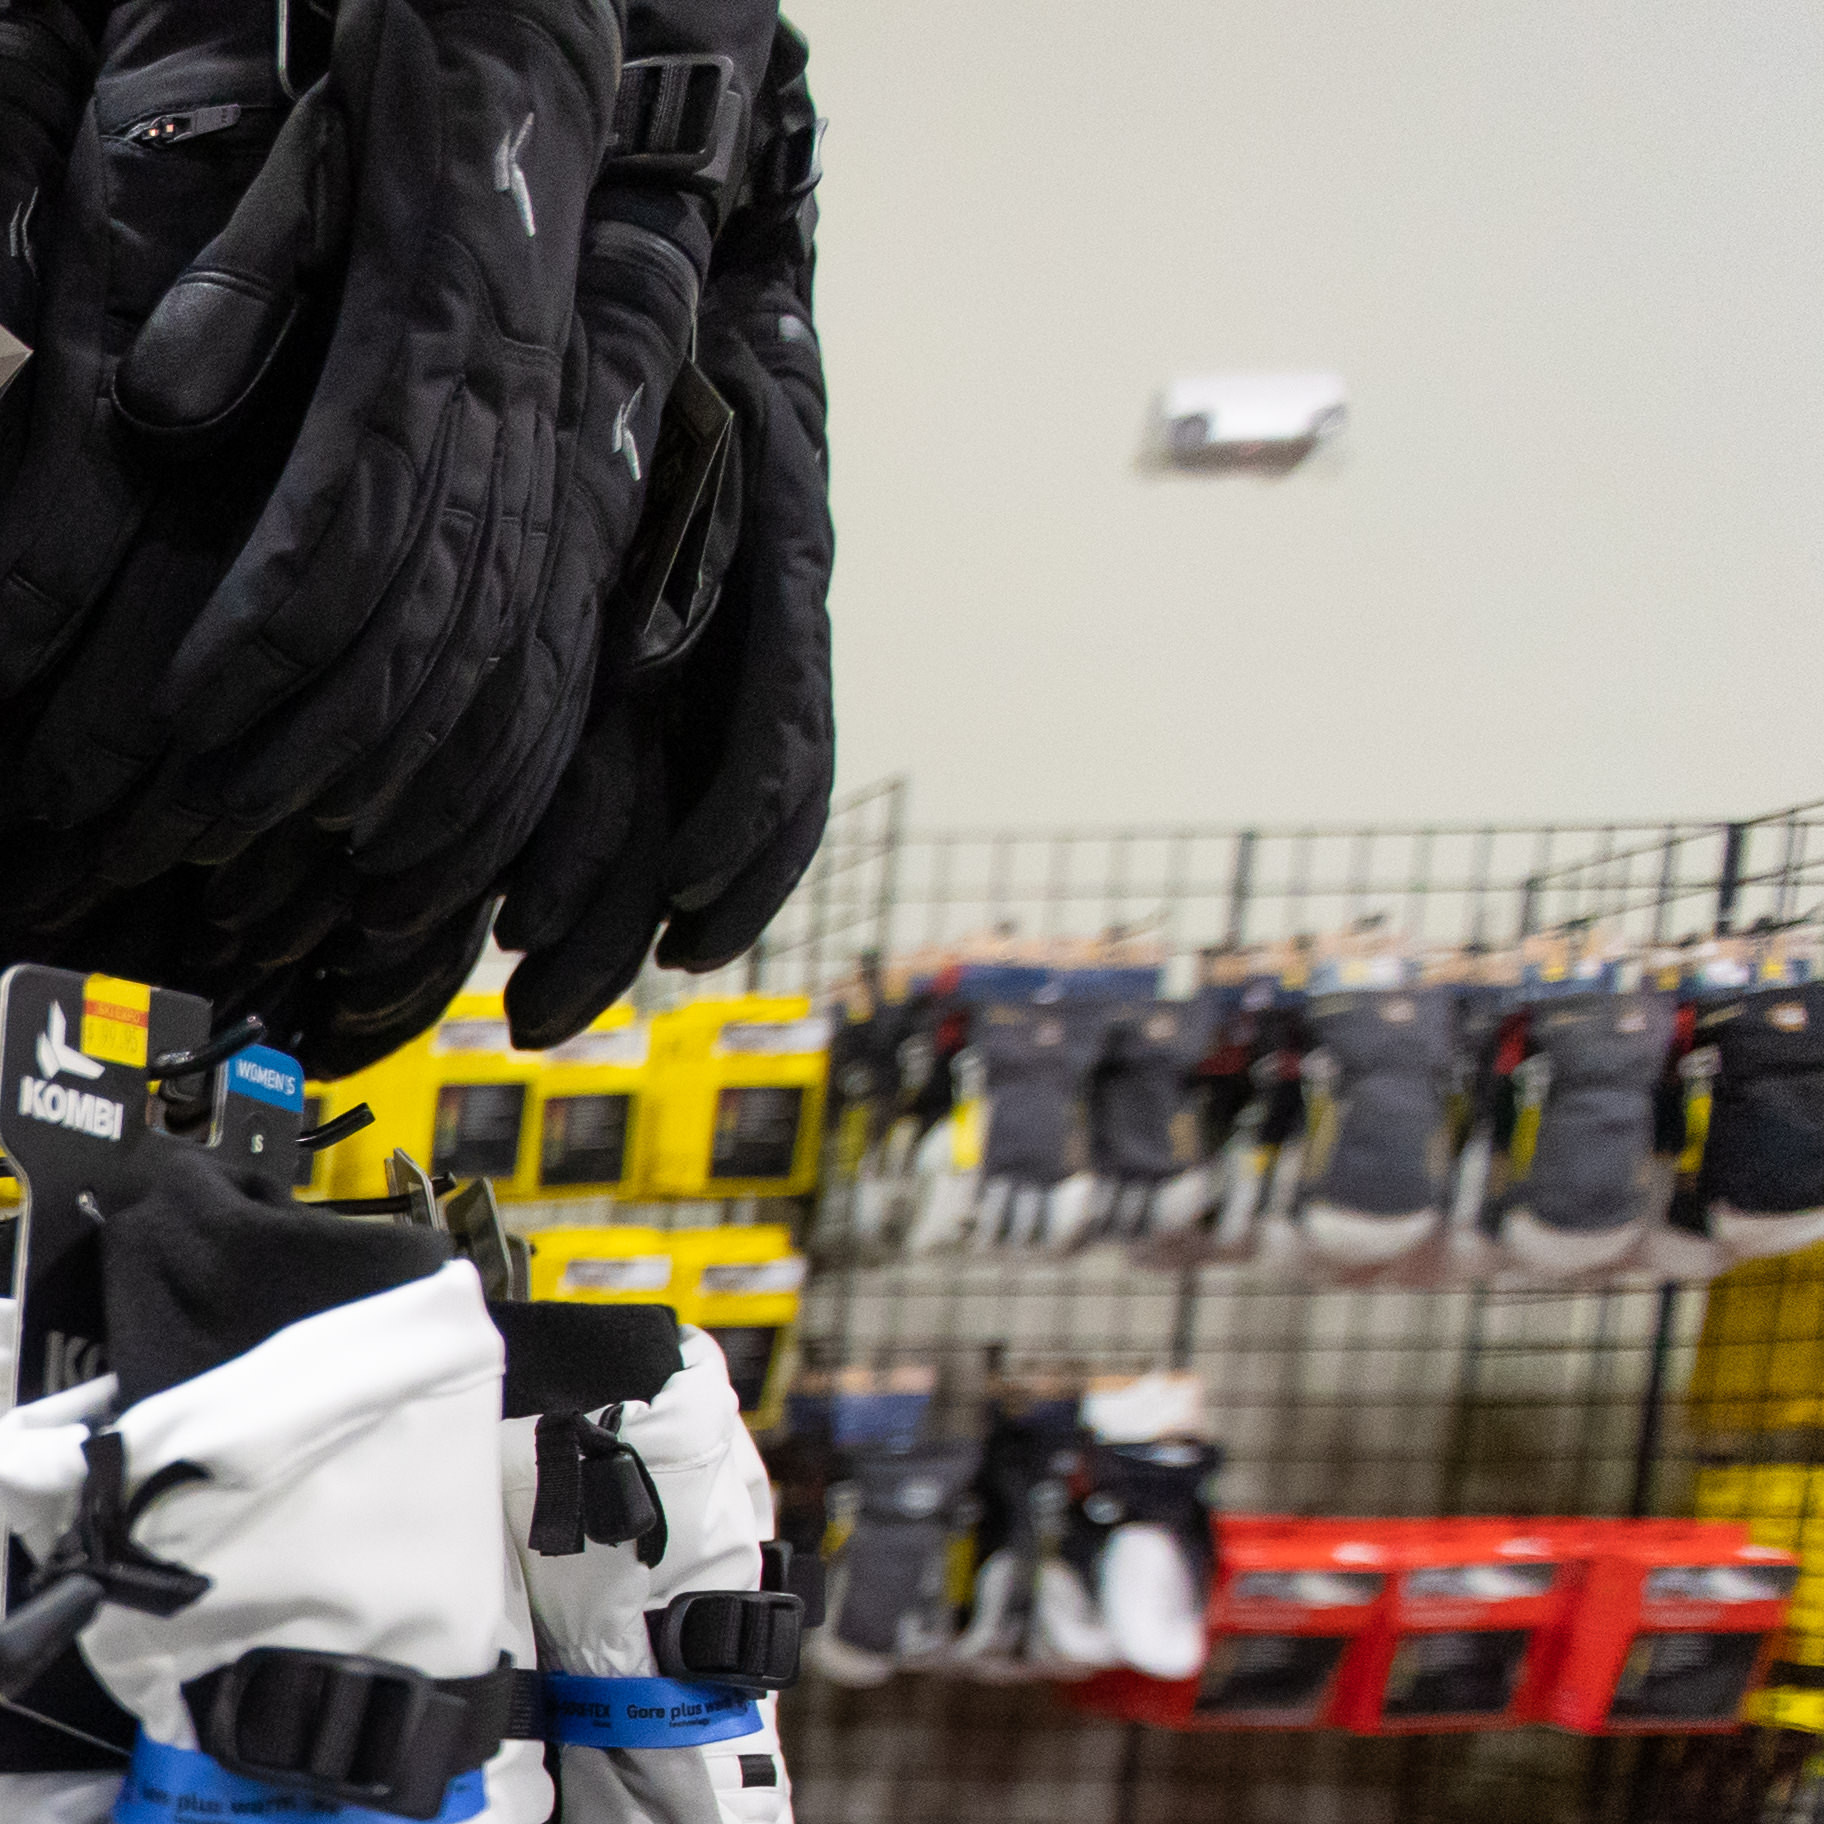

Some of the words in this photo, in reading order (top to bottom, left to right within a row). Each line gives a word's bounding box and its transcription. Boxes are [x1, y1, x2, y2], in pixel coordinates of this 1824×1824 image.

[235, 1059, 295, 1097] WOMEN'S
[19, 1076, 123, 1142] KOMBI
[250, 1134, 264, 1154] S
[625, 1703, 666, 1720] Gore
[669, 1702, 703, 1721] plus
